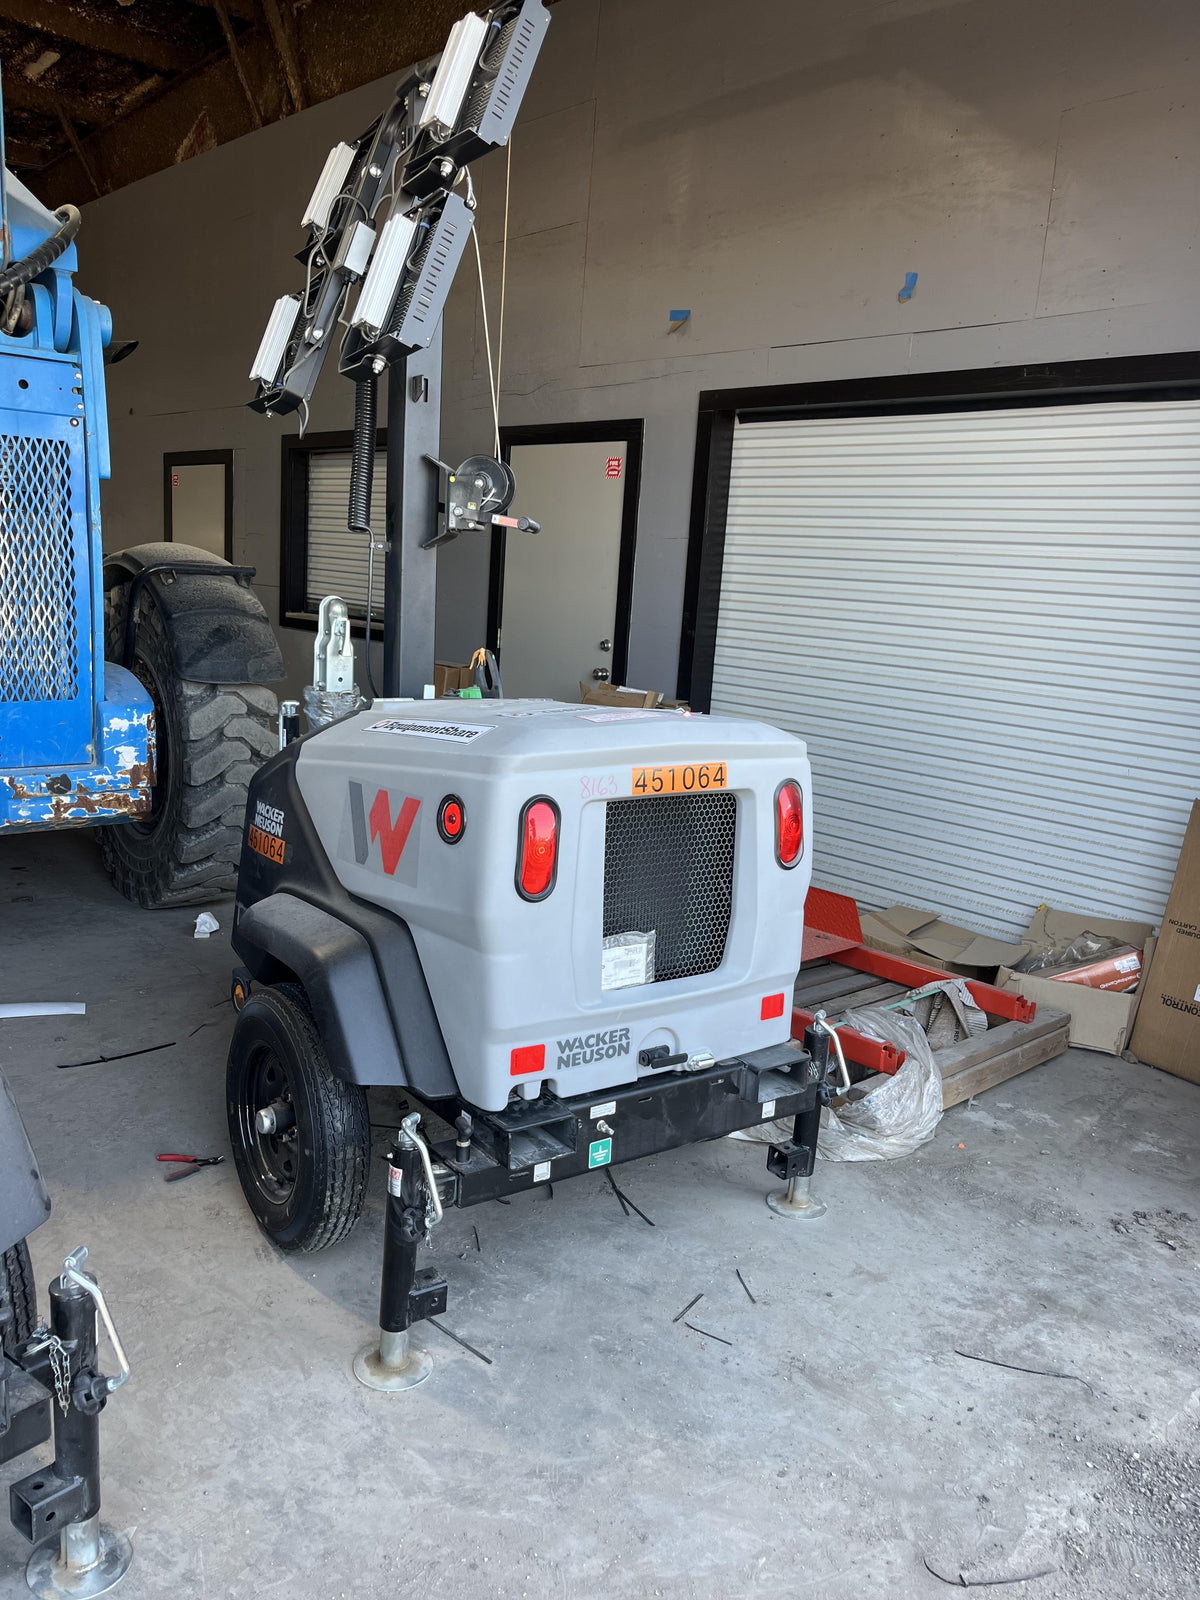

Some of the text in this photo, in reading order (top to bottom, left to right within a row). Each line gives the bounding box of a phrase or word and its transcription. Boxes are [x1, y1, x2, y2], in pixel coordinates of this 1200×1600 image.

[579, 776, 618, 799] 8163
[634, 764, 725, 793] 451064
[254, 813, 284, 837] NEUSON
[256, 800, 285, 825] WACKER
[249, 825, 283, 861] 451064
[556, 1027, 630, 1054] WACKER
[556, 1041, 630, 1070] NEUSON
